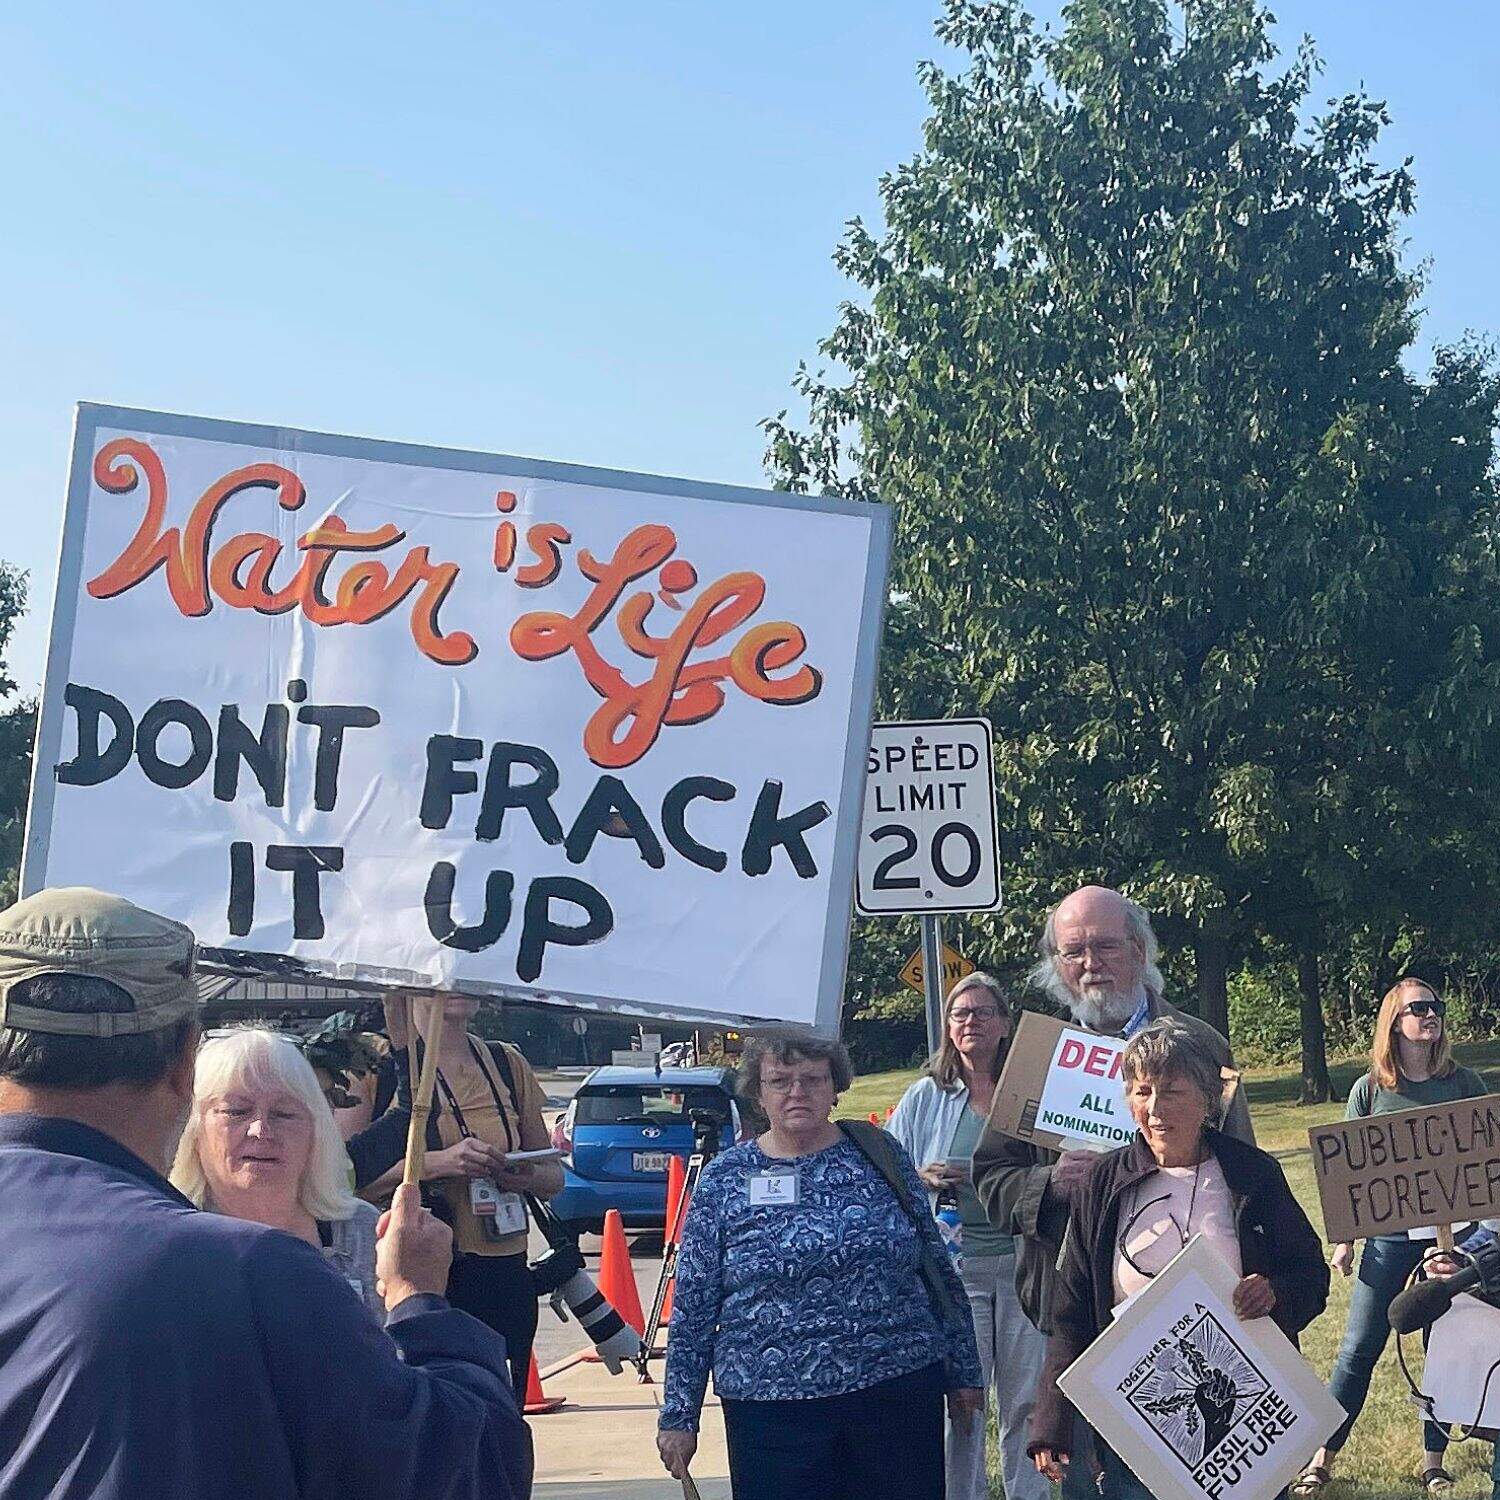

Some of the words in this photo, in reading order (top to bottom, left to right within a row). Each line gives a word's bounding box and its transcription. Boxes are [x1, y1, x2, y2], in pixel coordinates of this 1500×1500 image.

[88, 438, 478, 665] Water
[494, 491, 571, 587] is
[510, 524, 821, 768] Life
[55, 680, 380, 811] DON'T
[419, 735, 833, 878] FRACK
[868, 743, 979, 774] SPEED
[875, 783, 967, 812] LIMIT
[868, 821, 982, 890] 20
[229, 842, 344, 940] IT
[423, 861, 614, 983] UP
[912, 961, 962, 983] SW
[1042, 1110, 1137, 1144] NOMINATION
[1079, 1093, 1115, 1116] ALL
[1116, 1337, 1172, 1394] TOGETHER
[1168, 1313, 1194, 1338] FOR
[1194, 1302, 1206, 1315] A
[1192, 1433, 1249, 1490] FOSSIL
[1243, 1390, 1284, 1434] FREE
